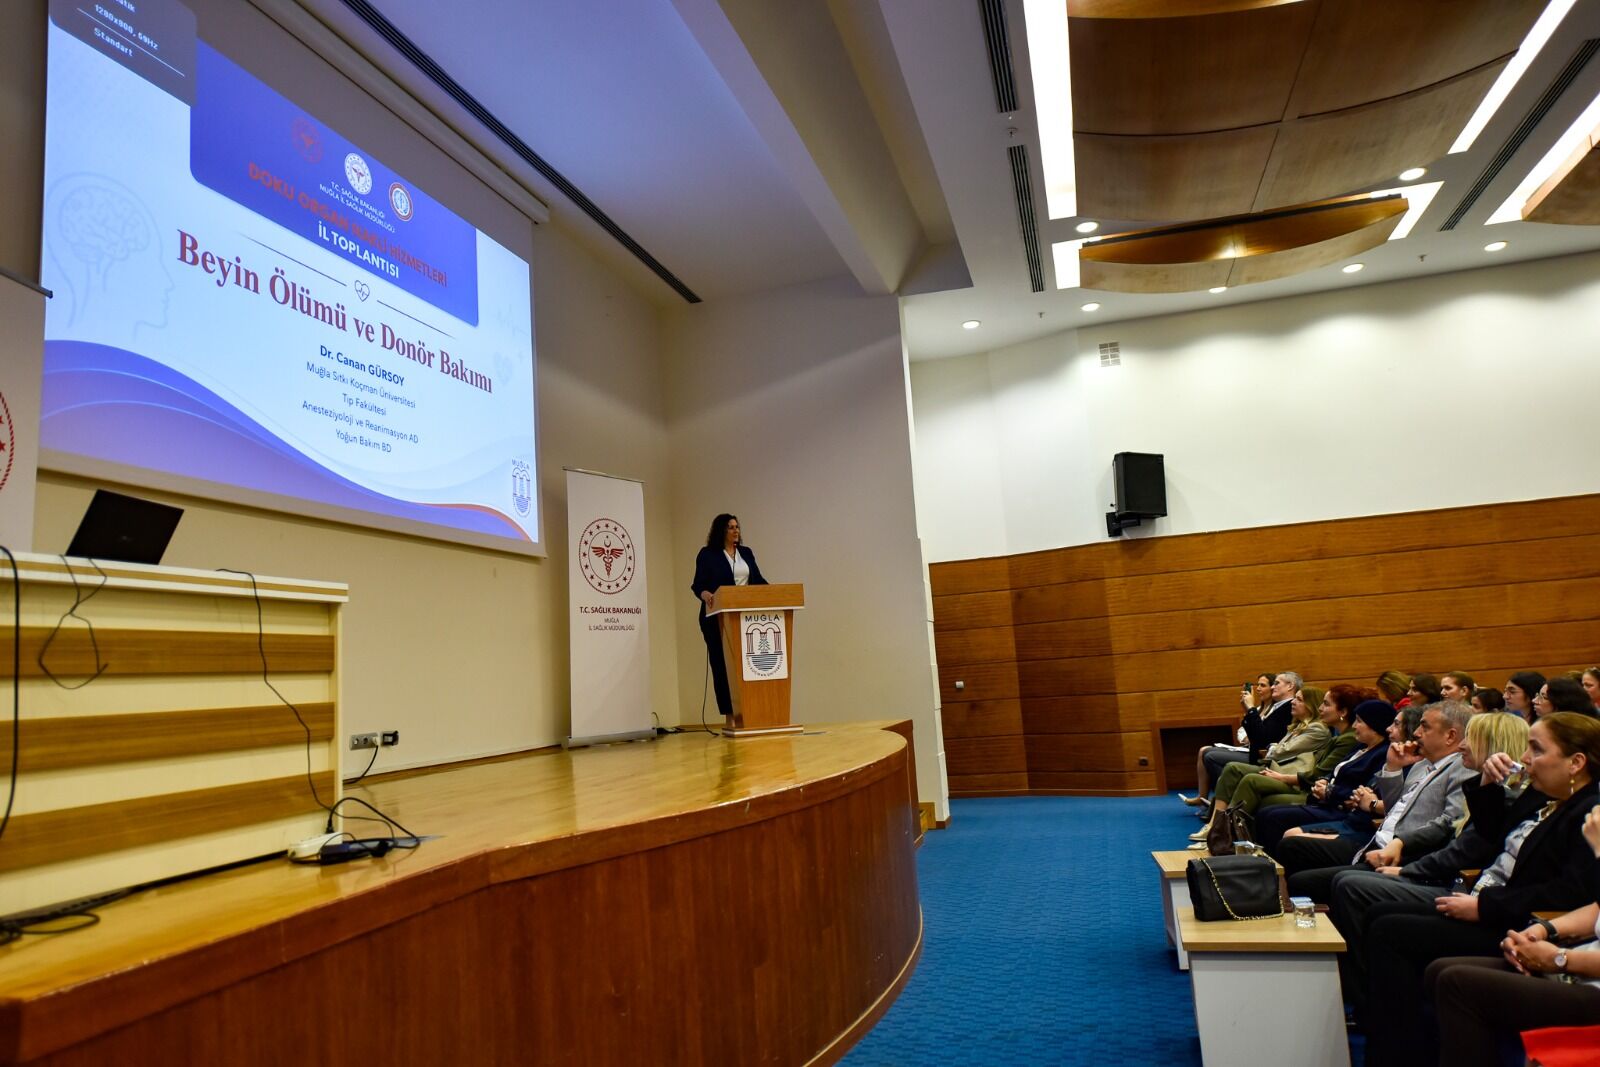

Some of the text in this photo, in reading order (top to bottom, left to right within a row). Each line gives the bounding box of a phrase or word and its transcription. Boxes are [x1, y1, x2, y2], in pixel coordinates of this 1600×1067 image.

[94, 27, 133, 57] Standart
[248, 161, 448, 288] DOKU ORGAN NAKLİ HİZMETLERİ
[318, 220, 399, 279] İL TOPLANTISI
[176, 229, 493, 394] Beyin Ölümü ve Donör Bakımı
[306, 361, 416, 409] Muğla Sıtkı Koçman Üniversitesi
[320, 345, 405, 387] Dr. Canan GÜRSOY
[302, 400, 419, 444] Anesteziyoloji ve Reanimasyon AD
[343, 393, 387, 416] Tıp Fakültesi
[335, 428, 358, 444] Yoğun
[381, 442, 392, 453] BD
[579, 605, 642, 615] T.C. SAĞLIK BAKANLIĞI
